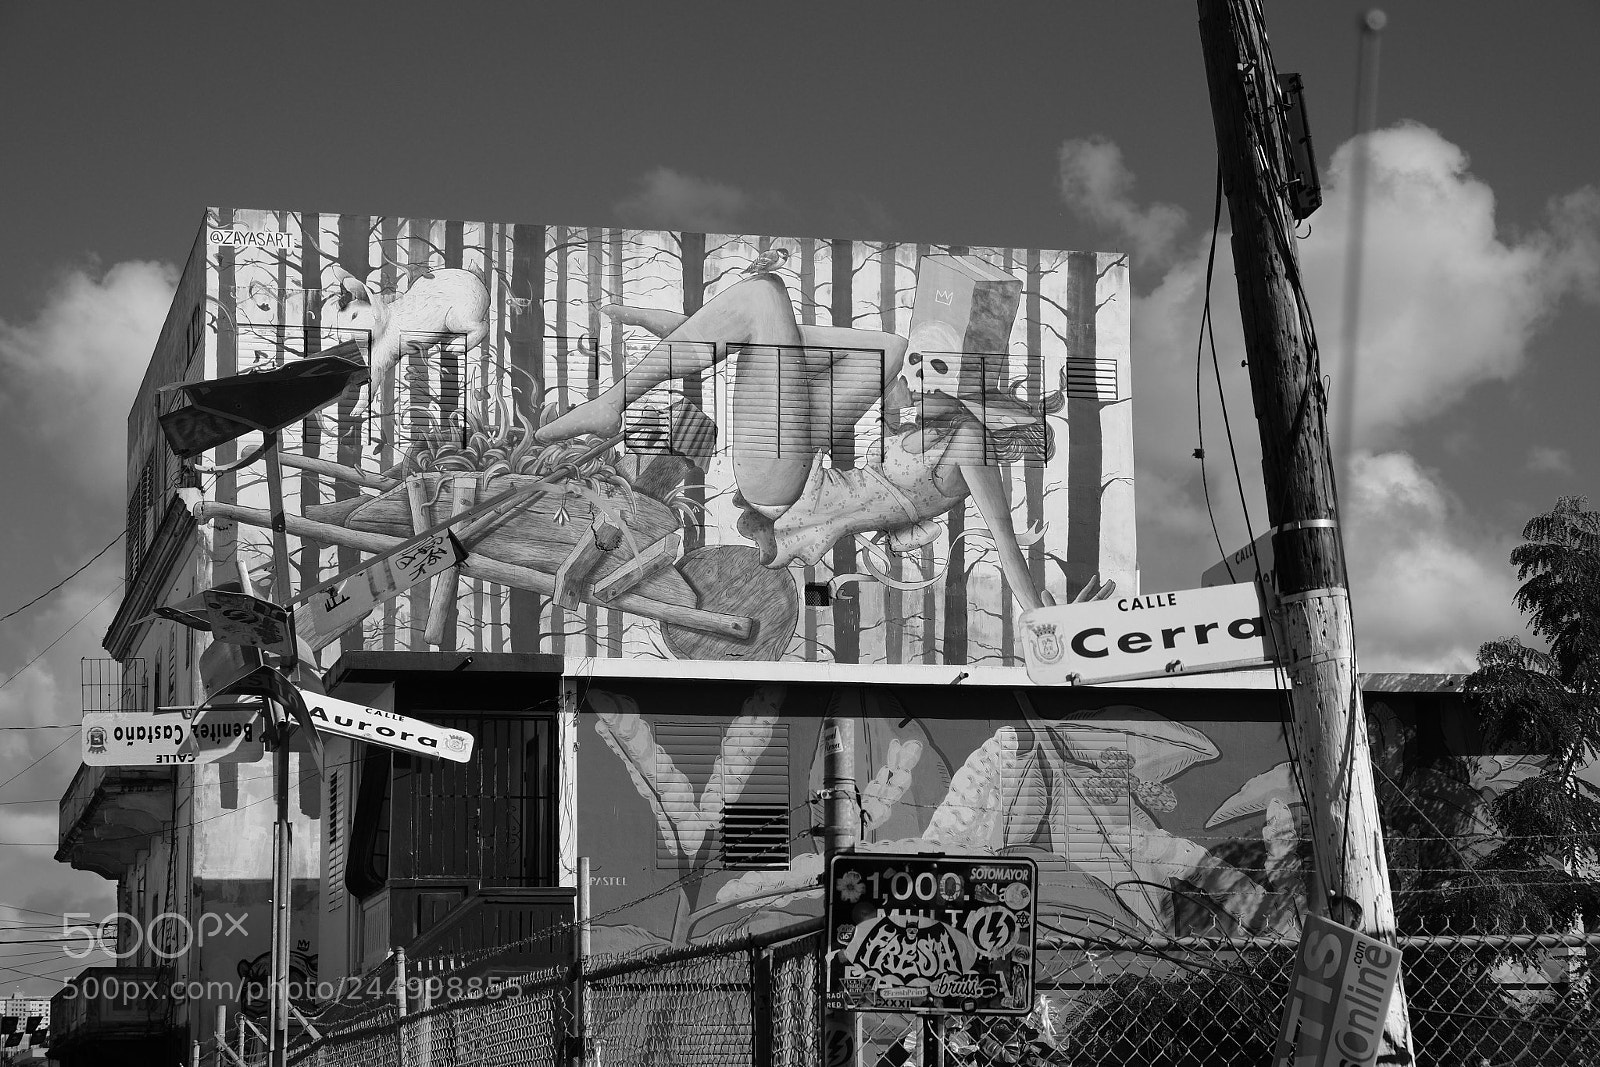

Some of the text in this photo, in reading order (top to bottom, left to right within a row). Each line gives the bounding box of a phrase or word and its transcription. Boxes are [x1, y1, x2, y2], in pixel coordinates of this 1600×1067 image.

[210, 230, 292, 248] @ZAYASART
[1235, 543, 1255, 565] CALL
[1117, 593, 1177, 612] CALLE
[1071, 616, 1267, 659] Cerra
[365, 707, 406, 722] CALLE
[113, 723, 184, 746] Castaño
[309, 706, 438, 748] Aurora
[156, 754, 196, 764] CALLE
[589, 876, 628, 886] PASTEL
[969, 867, 1029, 881] SOTOMAYOR
